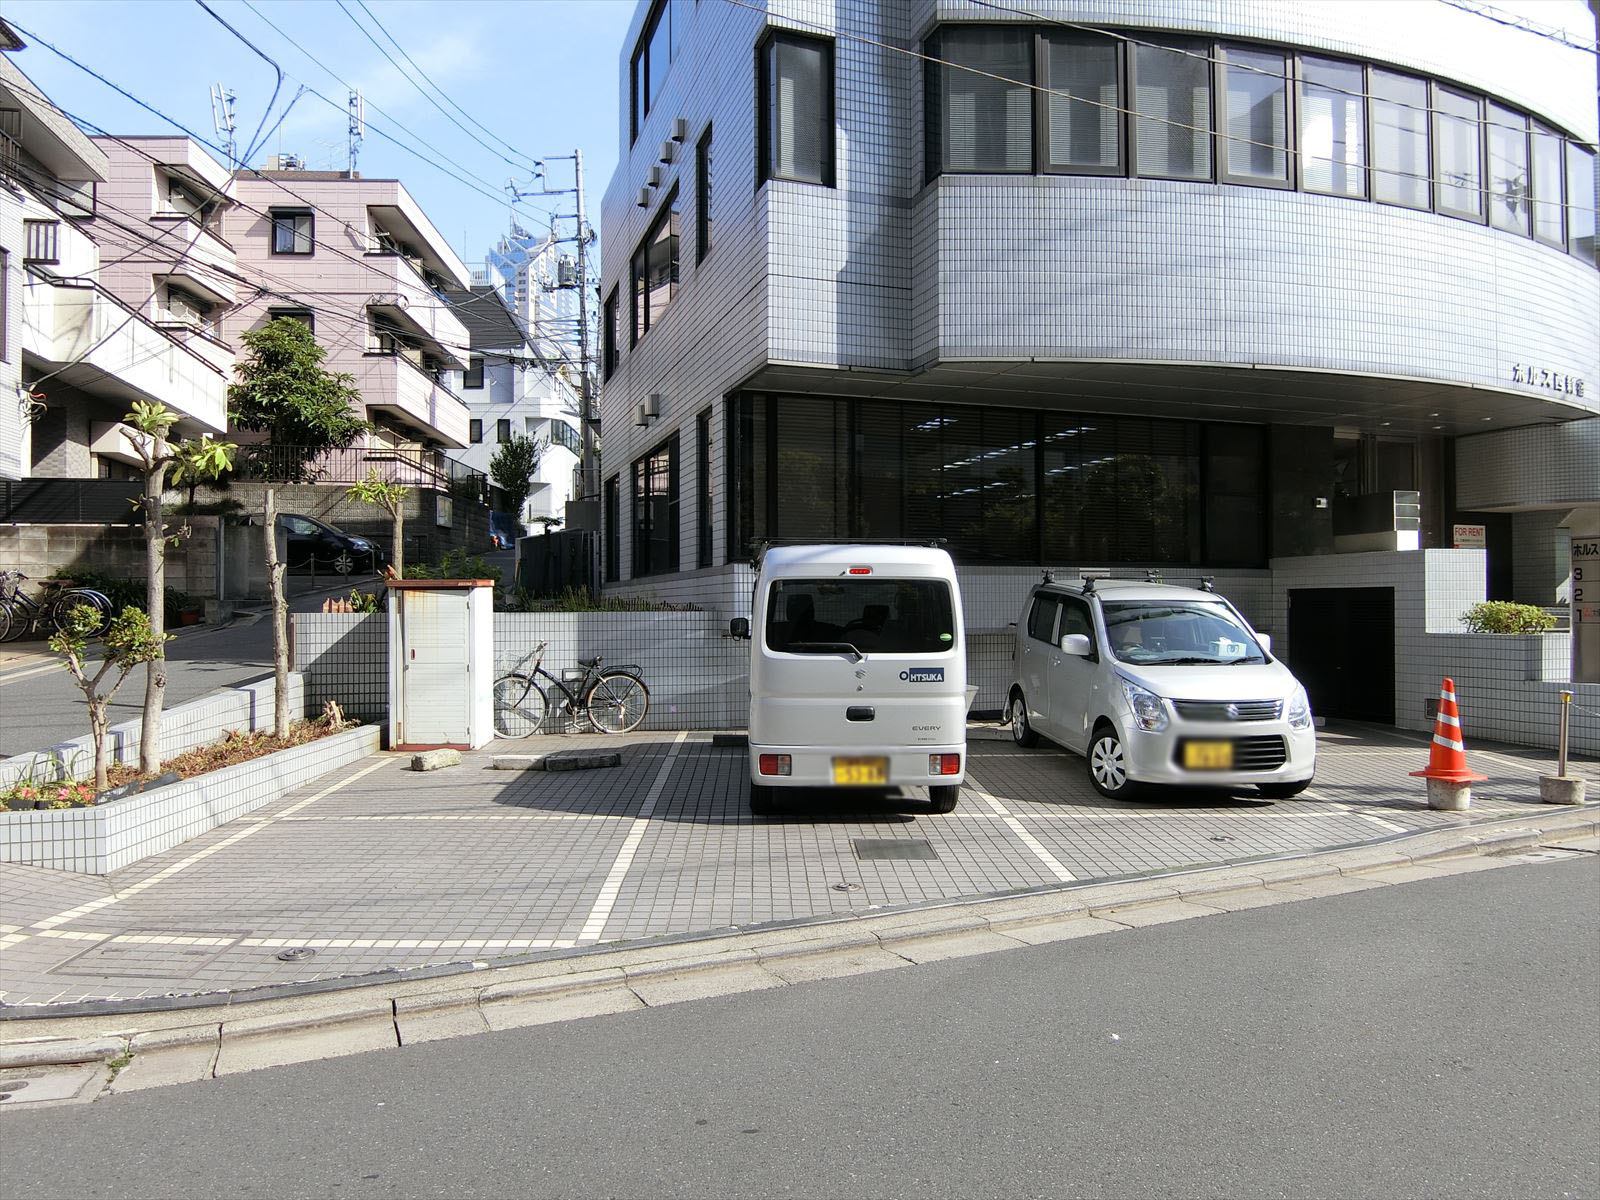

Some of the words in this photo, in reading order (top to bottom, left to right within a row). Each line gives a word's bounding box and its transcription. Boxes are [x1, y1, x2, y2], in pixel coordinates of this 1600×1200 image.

[1455, 527, 1467, 536] FOR
[1468, 527, 1484, 537] RENT
[1573, 543, 1599, 557] ホルス
[1573, 567, 1583, 581] 3
[1574, 588, 1583, 601] 2
[1576, 608, 1582, 621] 1
